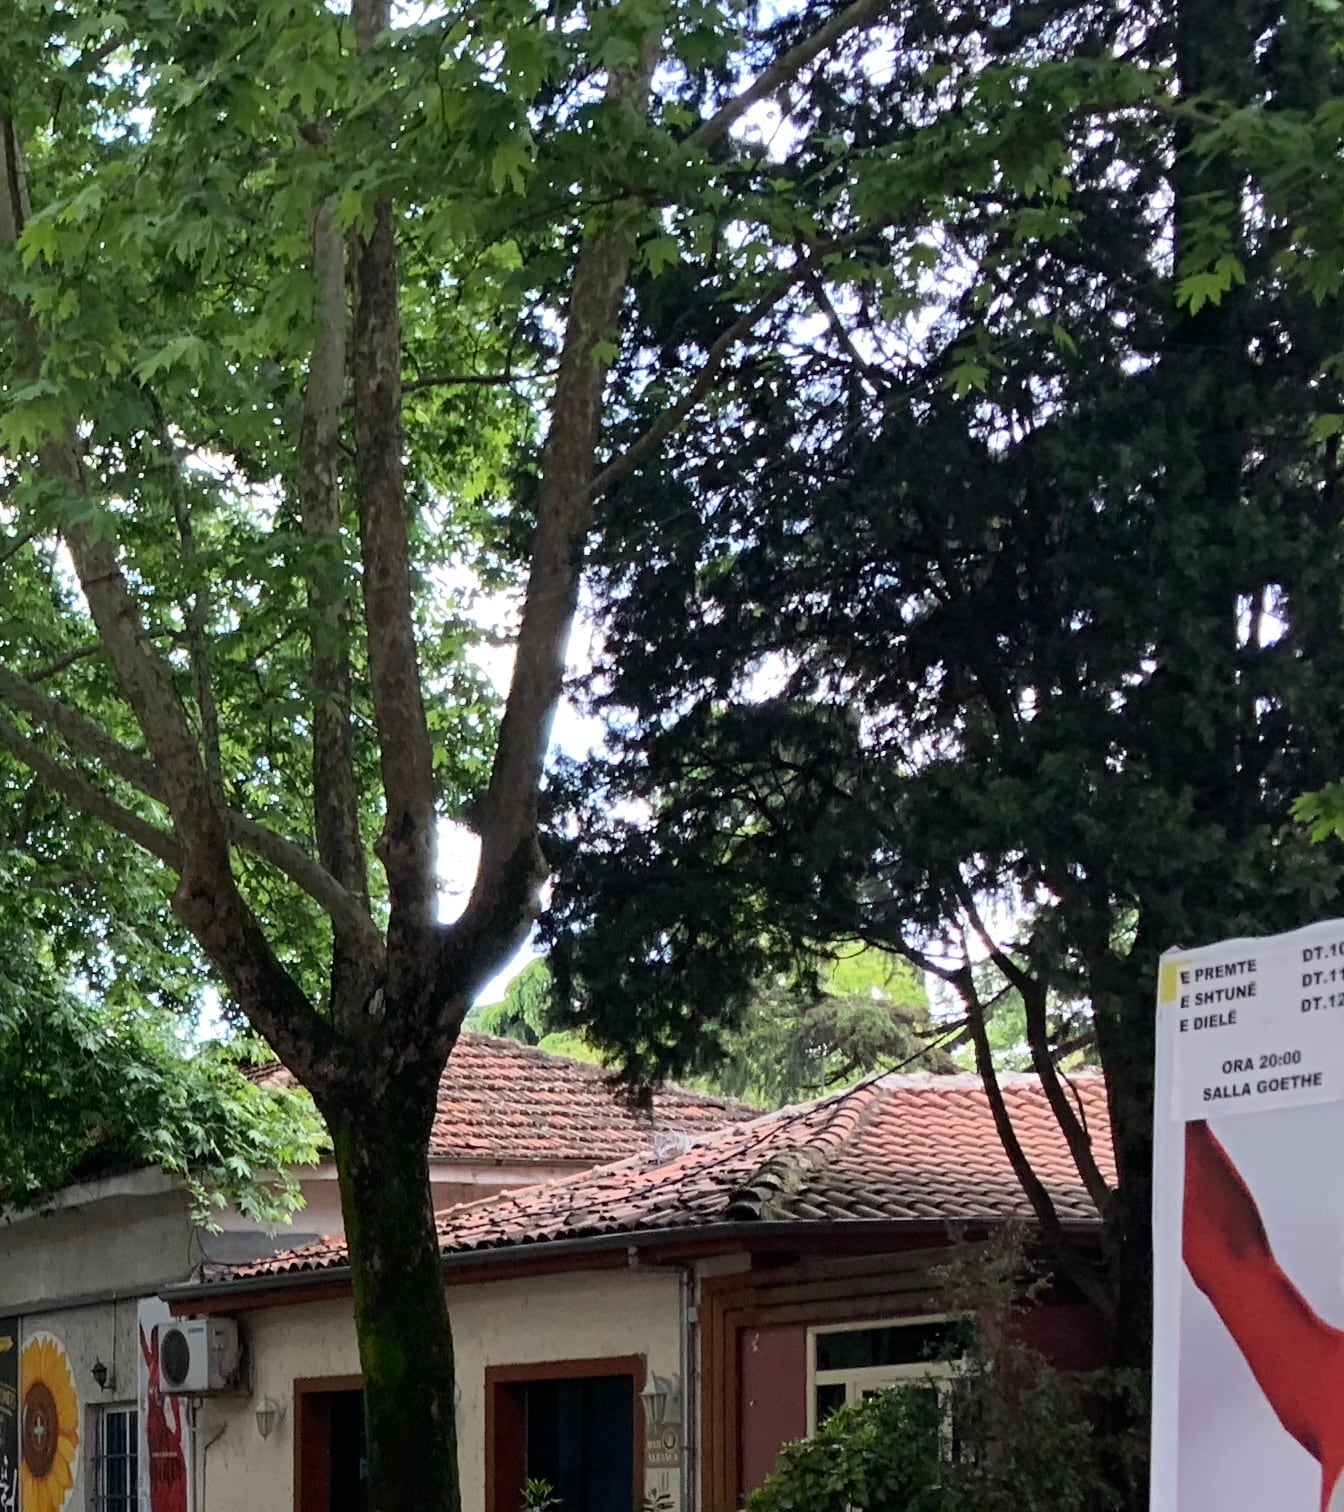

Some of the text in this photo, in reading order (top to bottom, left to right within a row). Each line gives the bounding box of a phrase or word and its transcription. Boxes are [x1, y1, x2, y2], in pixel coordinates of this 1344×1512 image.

[1179, 958, 1258, 985] E PREMTE
[1180, 981, 1257, 1009] E SHTUNË
[1179, 1009, 1237, 1032] E DIELË
[1221, 1050, 1302, 1074] ORA 20:00
[1203, 1072, 1323, 1102] SALLA GOETHE
